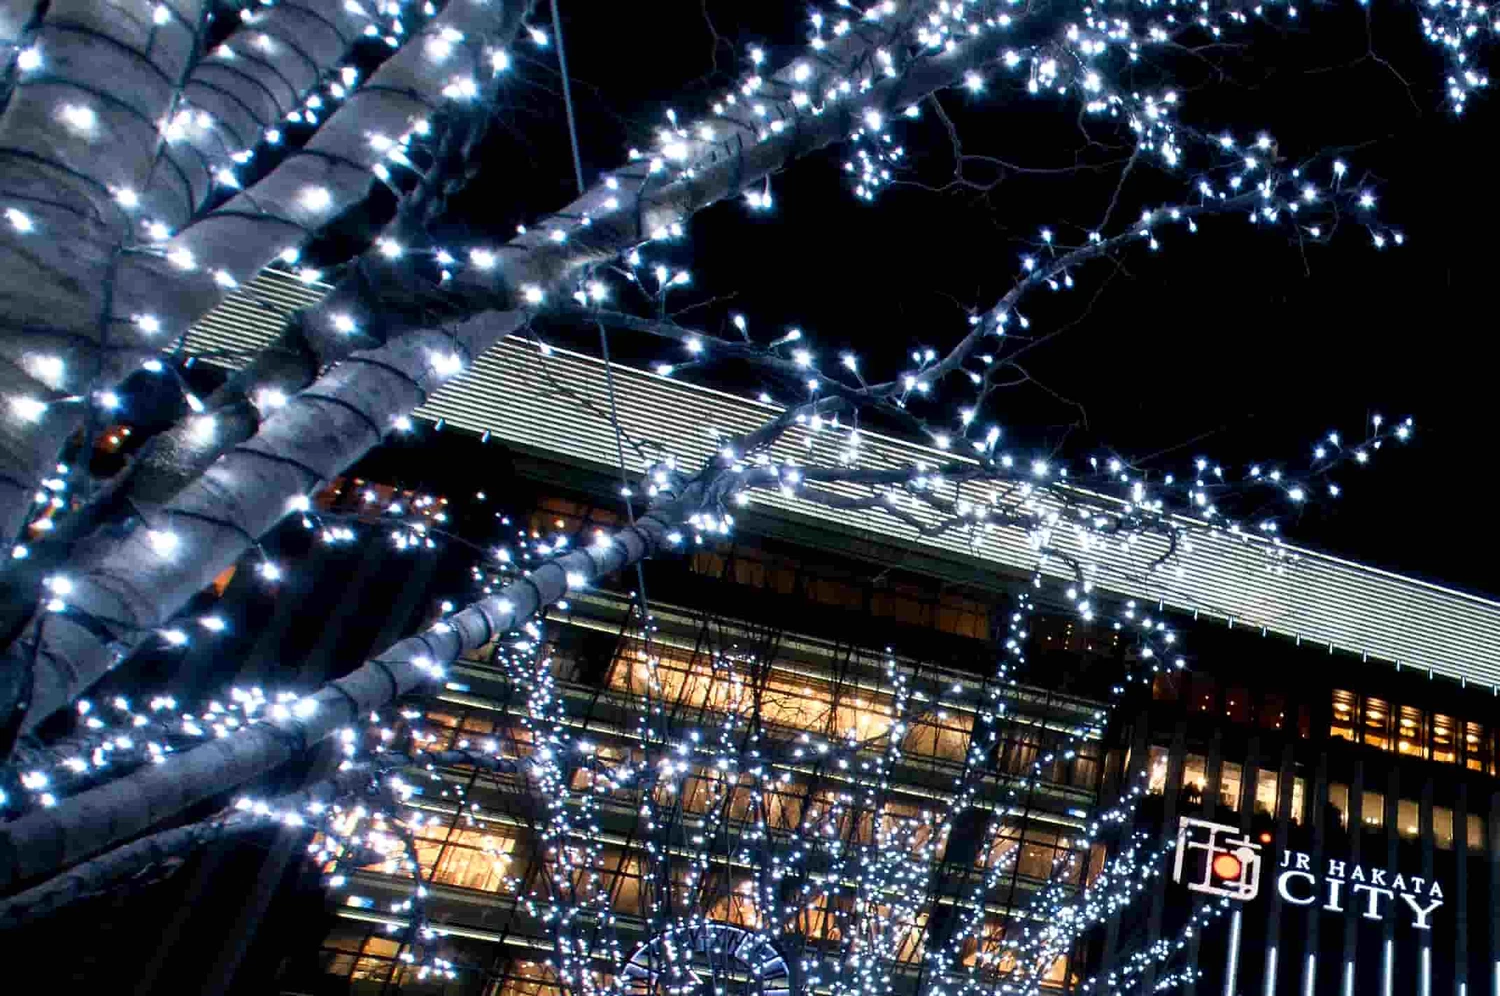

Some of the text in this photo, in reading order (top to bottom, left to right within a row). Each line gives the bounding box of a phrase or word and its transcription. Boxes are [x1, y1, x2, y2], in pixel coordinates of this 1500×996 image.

[1277, 870, 1444, 929] CITY
[1280, 850, 1444, 899] JR HAKATA
